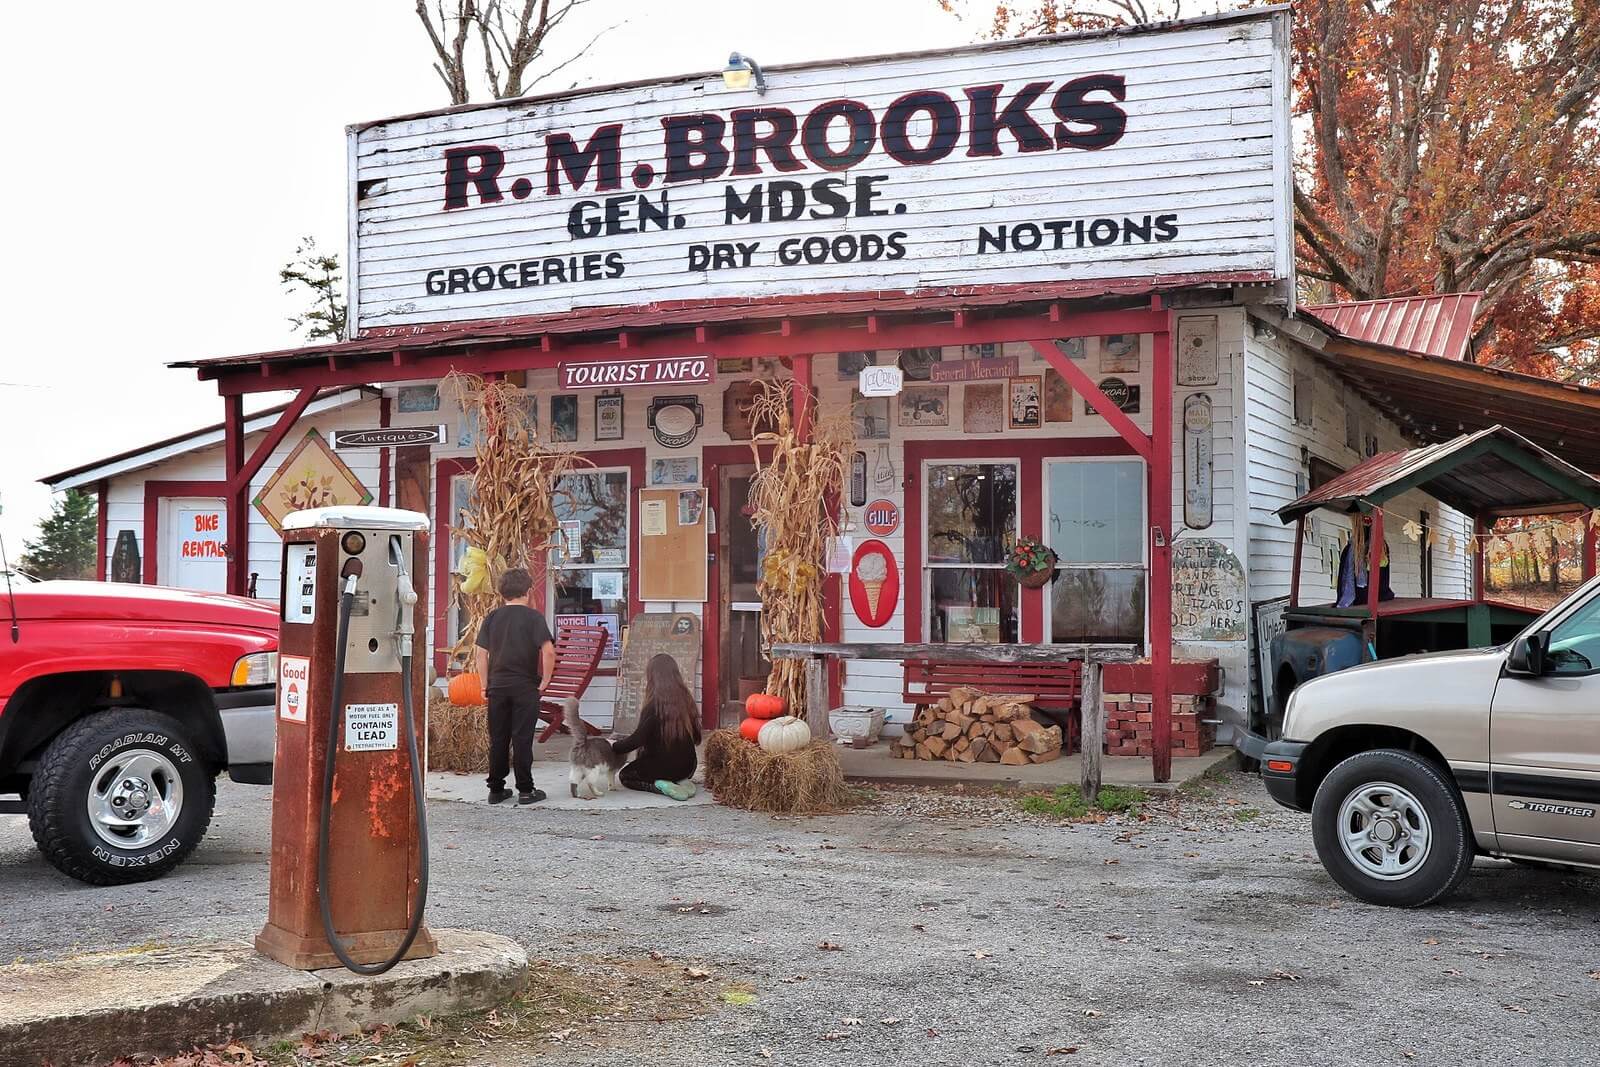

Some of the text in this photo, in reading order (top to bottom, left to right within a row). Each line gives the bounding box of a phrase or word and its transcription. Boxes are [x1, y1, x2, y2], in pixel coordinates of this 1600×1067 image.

[567, 174, 908, 240] GEN. MDSE.
[425, 213, 1179, 297] GROCERIES DRY GOODS NOTIONS
[565, 360, 710, 385] TOURIST INFO.
[930, 362, 968, 382] General
[1100, 387, 1128, 397] KOAL
[344, 431, 428, 444] Antiques
[194, 514, 220, 533] BIKE
[867, 509, 897, 528] GULF
[182, 540, 226, 558] RENTAL
[1175, 546, 1215, 559] NITE
[1172, 559, 1234, 571] RAWLERS
[1185, 571, 1209, 581] AND
[1171, 580, 1220, 597] RING
[1182, 598, 1244, 614] LIZARDS
[557, 617, 585, 627] NOTICE
[1171, 611, 1238, 629] OLD HERE
[282, 662, 307, 681] Good
[351, 720, 393, 730] CONTAINS
[357, 730, 387, 741] LEAD
[88, 732, 193, 771] ROADIAN MT
[1527, 802, 1594, 817] TRACKER
[91, 837, 181, 868] NEXEN
